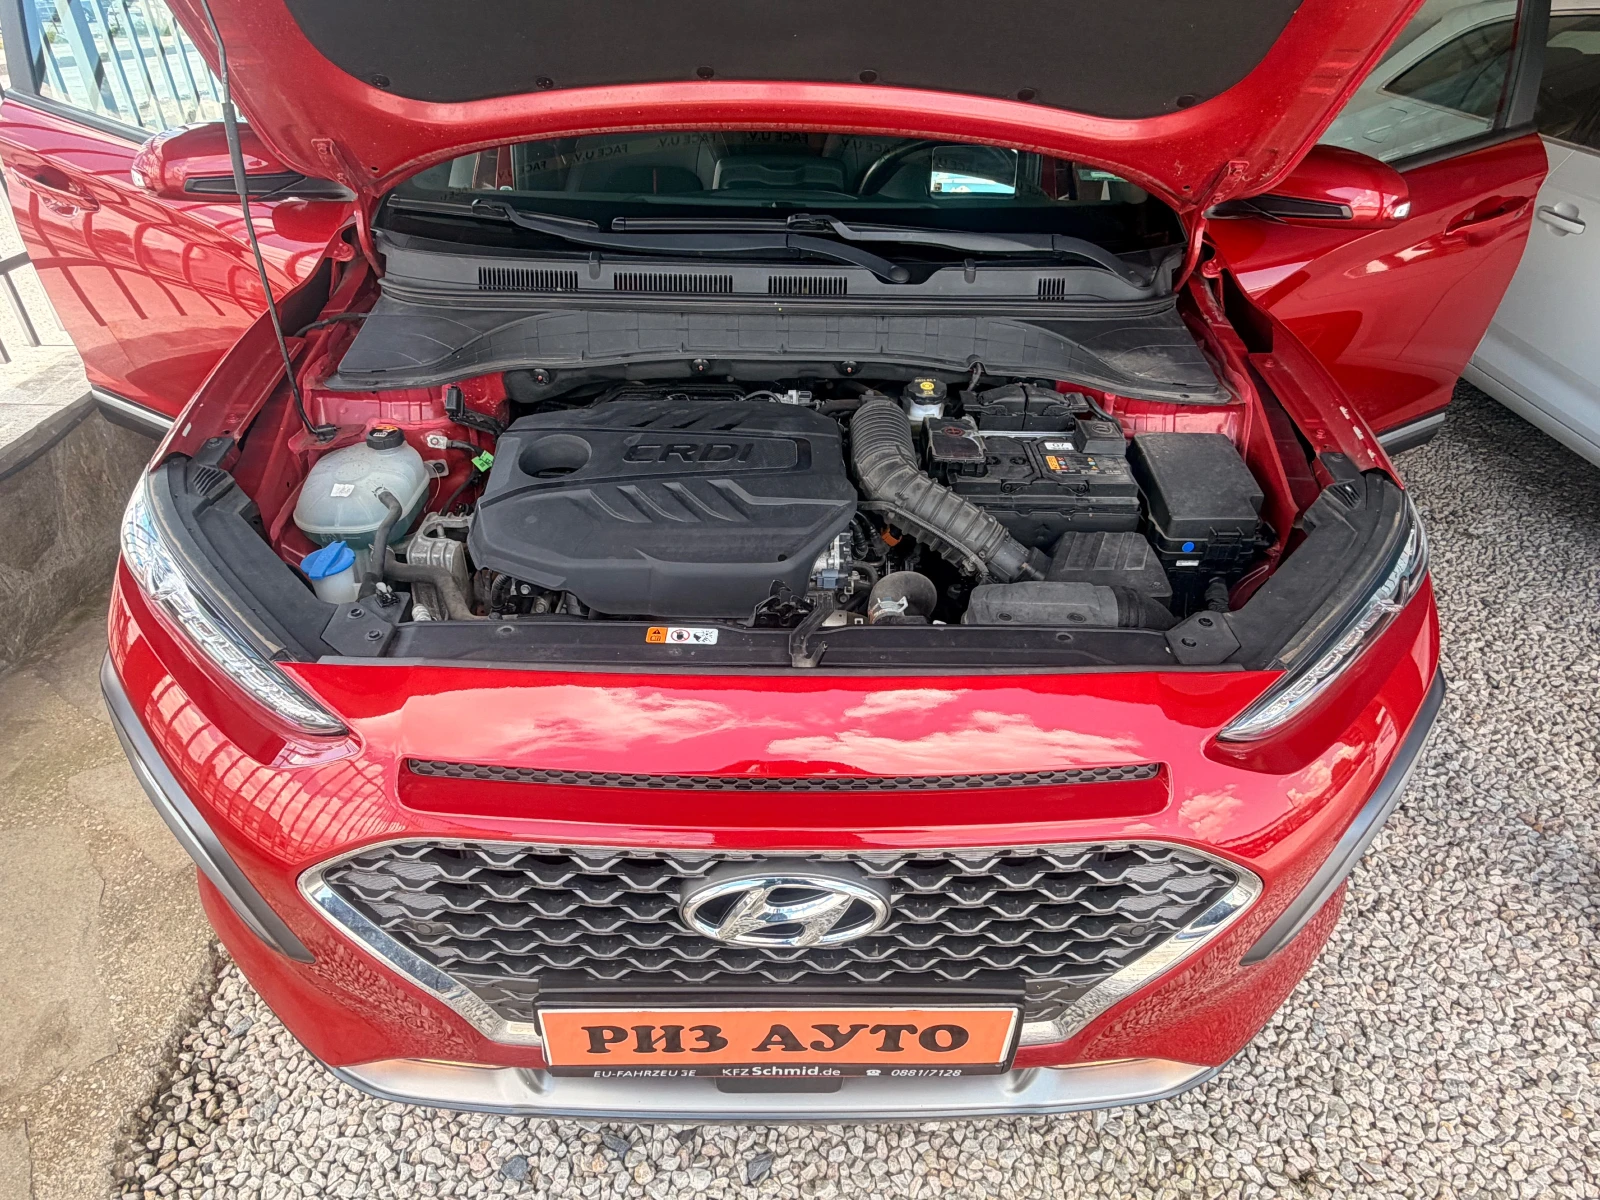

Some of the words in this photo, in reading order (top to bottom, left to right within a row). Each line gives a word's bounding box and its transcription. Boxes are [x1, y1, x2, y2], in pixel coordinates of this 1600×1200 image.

[622, 443, 754, 463] CRDI
[581, 1023, 729, 1053] РИЗ
[751, 1023, 970, 1053] АУТО
